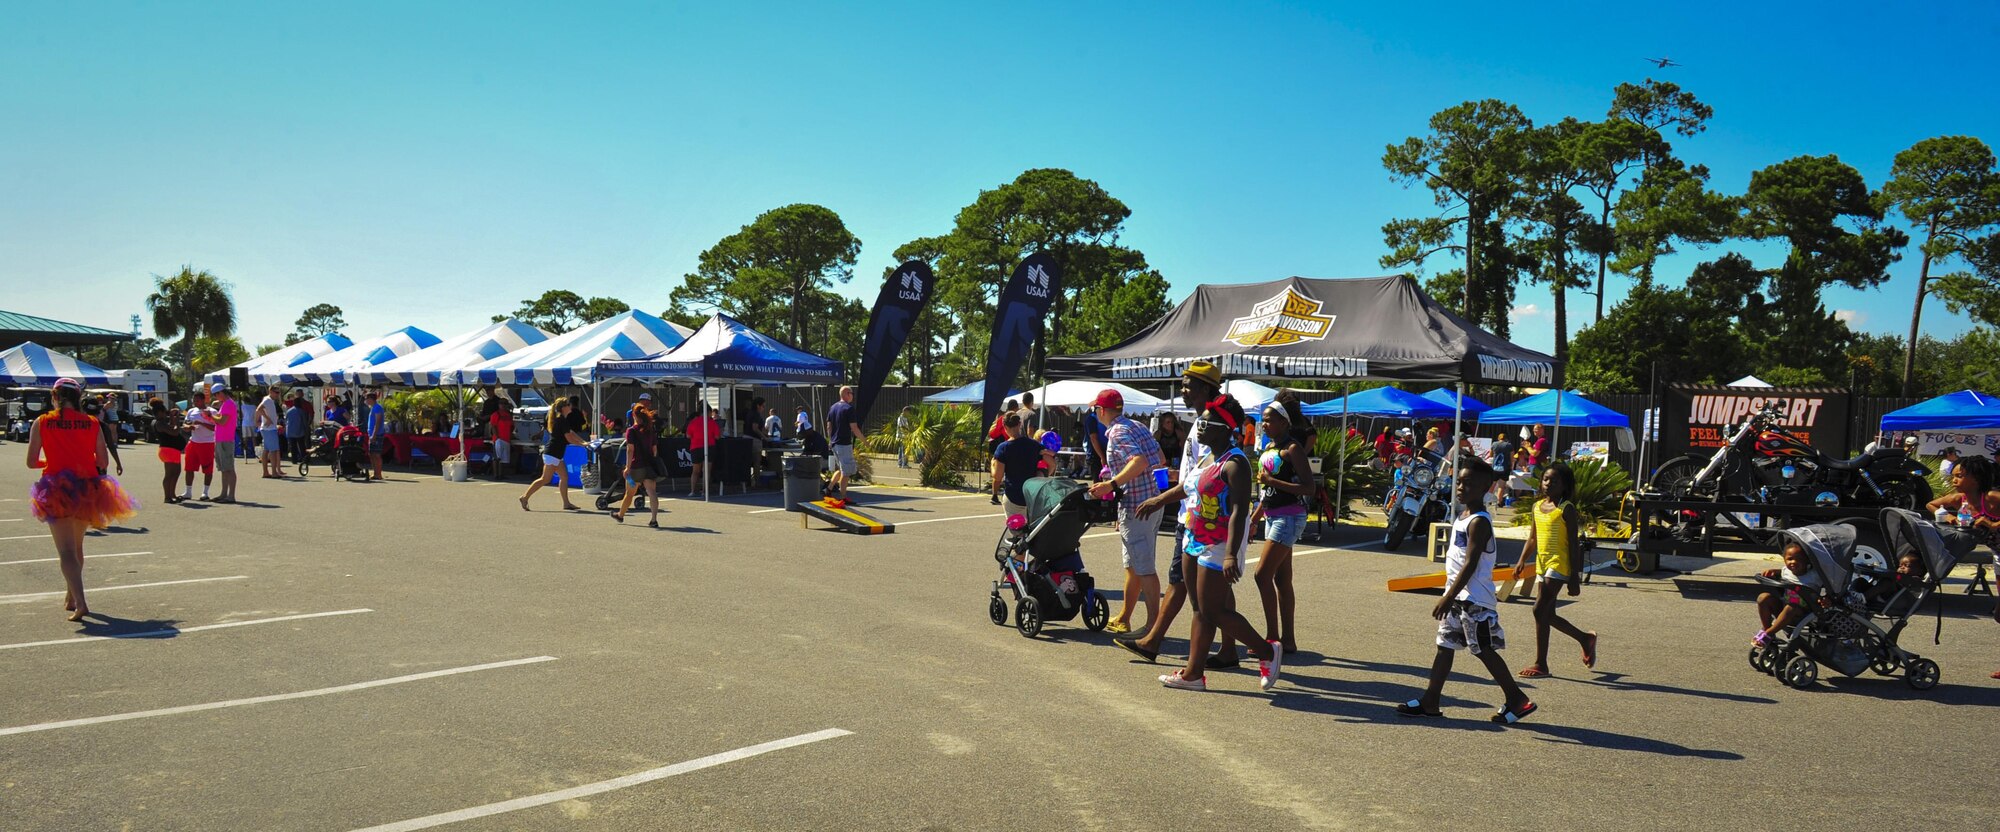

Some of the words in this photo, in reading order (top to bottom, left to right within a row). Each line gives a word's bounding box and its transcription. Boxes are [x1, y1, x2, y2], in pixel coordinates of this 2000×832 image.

[899, 290, 920, 301] USAA
[1026, 285, 1047, 298] USAA
[1234, 313, 1323, 335] HARLEY-DAVIDSON
[616, 362, 630, 370] KNOW
[631, 362, 645, 370] WHAT
[645, 362, 651, 370] IT
[652, 362, 669, 370] MEANS
[670, 362, 677, 370] TO
[677, 362, 693, 370] SERVE
[722, 363, 734, 371] WE
[735, 364, 755, 372] KNOW
[756, 365, 774, 373] WHAT
[784, 367, 804, 375] MEANS
[1112, 357, 1172, 379] EMERALD
[1221, 353, 1368, 377] HARLEY-DAVIDSON
[1477, 354, 1517, 381] EMERALD
[1514, 358, 1539, 384] COAST
[46, 419, 73, 430] FITNESS
[74, 419, 92, 430] STAFF
[1690, 428, 1721, 440] FEEL
[1925, 432, 1978, 446] FOCUS
